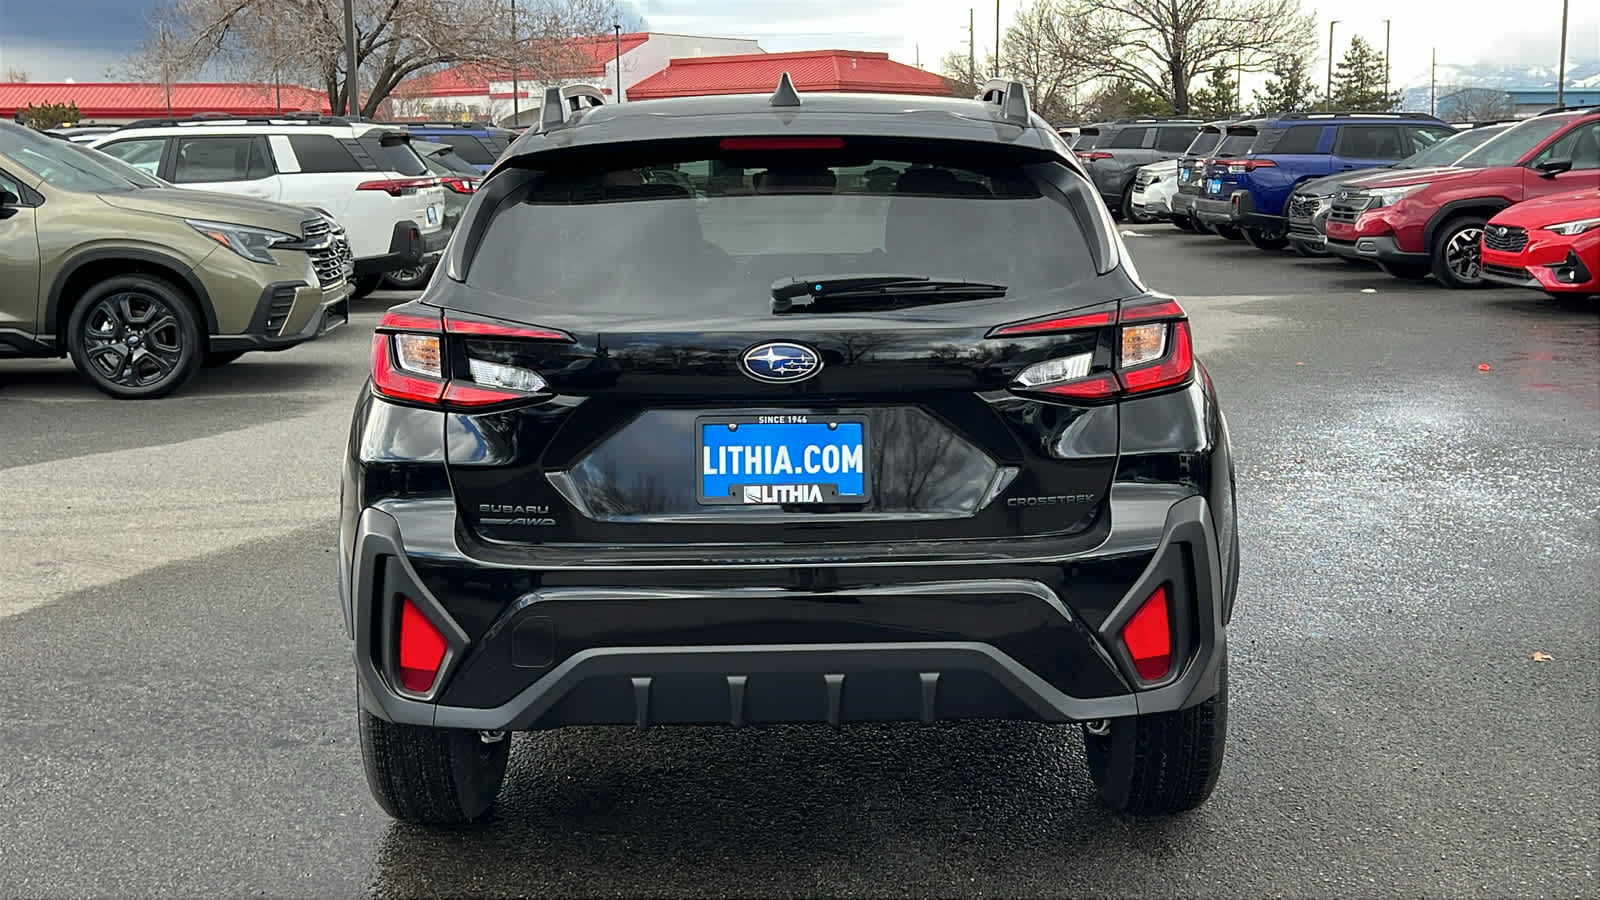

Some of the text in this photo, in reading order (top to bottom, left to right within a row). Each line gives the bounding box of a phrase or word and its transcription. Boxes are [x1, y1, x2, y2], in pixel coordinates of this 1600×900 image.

[758, 416, 808, 424] SINCE 1946
[703, 444, 863, 475] LITHIA.COM
[761, 484, 823, 503] LITHIA
[1007, 494, 1094, 506] CROSSTREK
[479, 504, 549, 514] SUBARU
